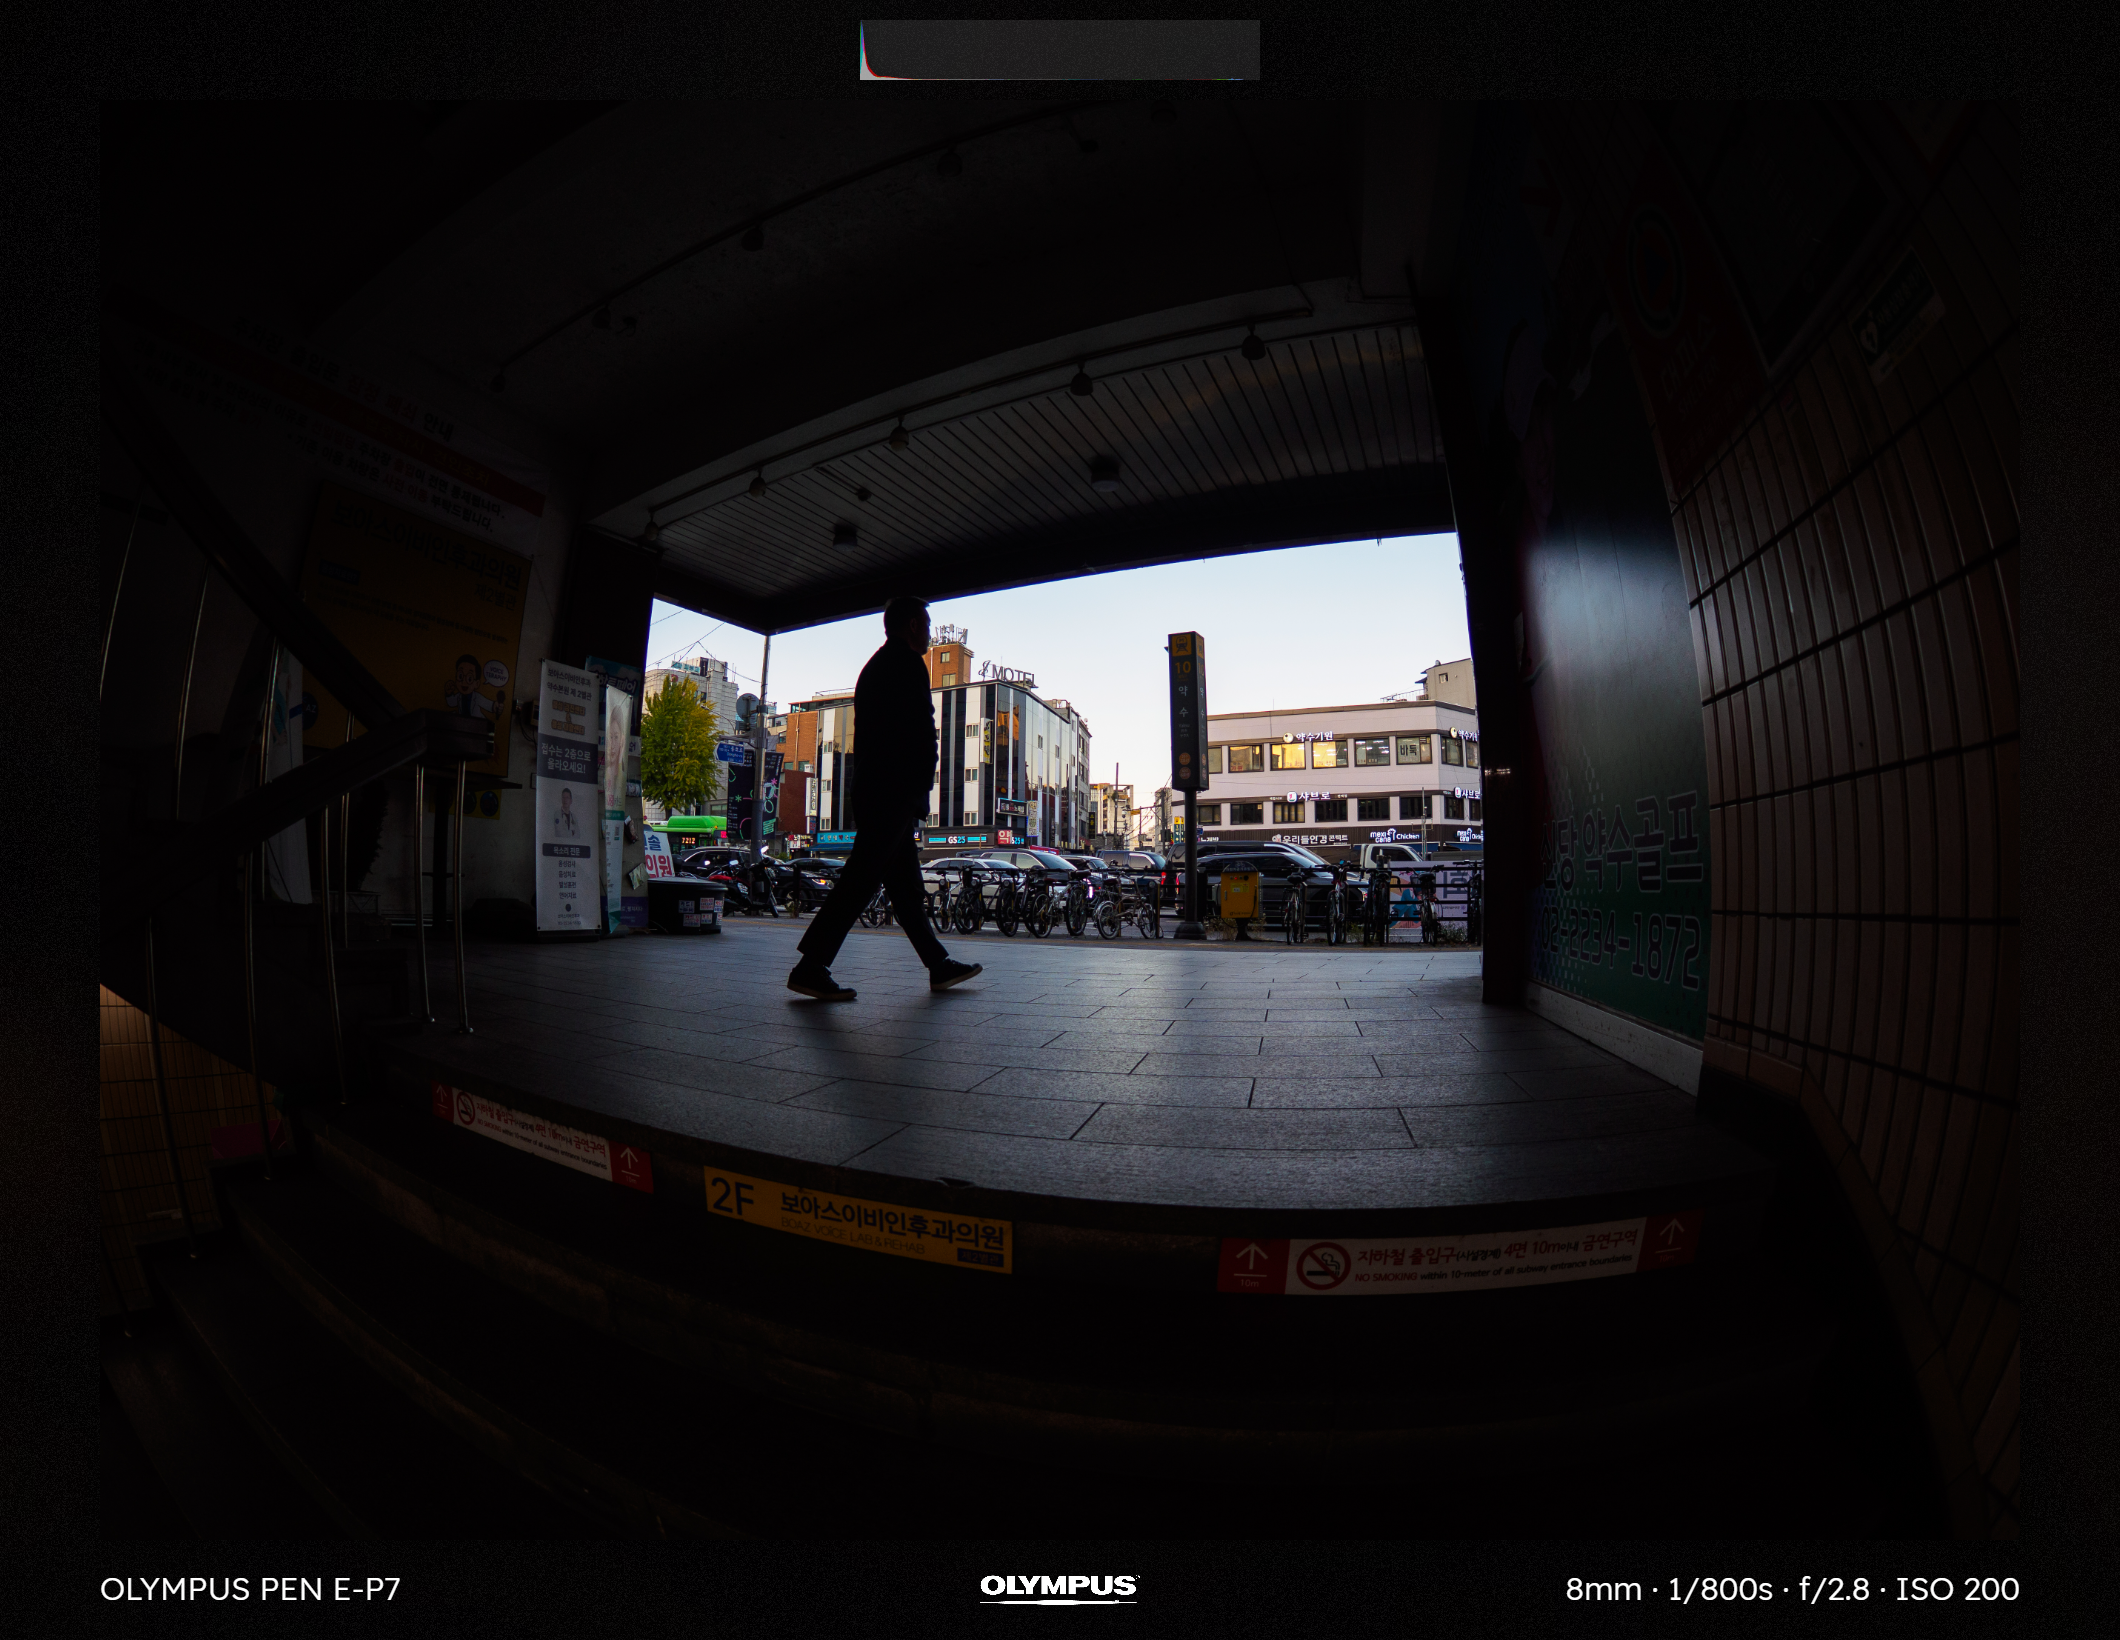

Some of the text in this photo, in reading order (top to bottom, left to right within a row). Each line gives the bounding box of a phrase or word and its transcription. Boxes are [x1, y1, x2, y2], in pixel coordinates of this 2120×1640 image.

[231, 316, 284, 355] 주차장
[424, 411, 454, 441] 안내
[358, 442, 392, 467] 주차장
[1174, 661, 1191, 674] 10
[1295, 731, 1334, 742] 약수기원
[1400, 744, 1417, 756] 바둑
[681, 836, 696, 844] 7212
[948, 836, 966, 844] GS25
[999, 831, 1010, 843] 약
[1541, 905, 1700, 991] 02-2234-1872
[573, 1135, 606, 1158] 금연구역
[625, 1176, 637, 1185] 10m
[710, 1176, 755, 1217] 2F
[781, 1191, 1005, 1250] 보아스이비인후과의원
[781, 1216, 811, 1233] BOAZ
[1357, 1247, 1405, 1266] 지하철
[1503, 1240, 1527, 1259] 4면
[1582, 1228, 1639, 1252] 금연구역
[961, 1250, 1001, 1266] 제2별관
[1355, 1253, 1633, 1282] NO SMOKING within 10-meter of all subway entrance boundaries
[1240, 1278, 1260, 1288] 10m
